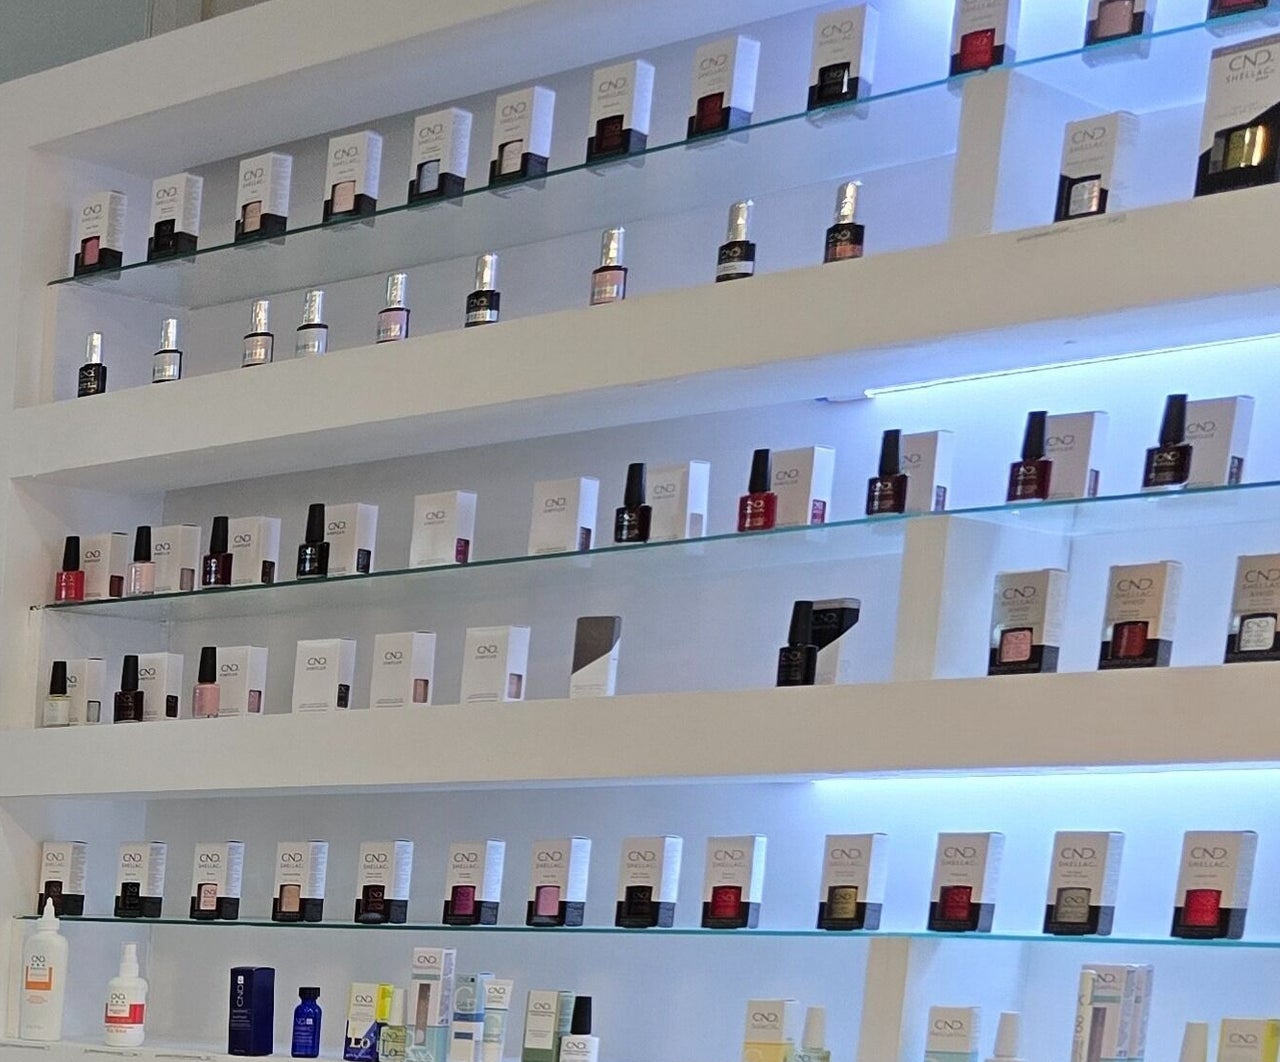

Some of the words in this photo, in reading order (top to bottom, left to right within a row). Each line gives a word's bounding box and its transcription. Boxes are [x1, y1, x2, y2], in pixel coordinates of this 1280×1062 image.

[1072, 127, 1106, 143] CND
[1117, 578, 1153, 593] CND
[1003, 586, 1036, 600] CND
[123, 853, 142, 862] CND
[199, 853, 220, 862] CND
[281, 853, 303, 862] CND
[364, 853, 388, 863] CND
[453, 852, 478, 863] CND
[537, 851, 562, 862] CND
[628, 851, 656, 862] CND
[714, 850, 745, 861] CND
[831, 848, 862, 860] CND
[944, 847, 976, 859] CND
[1061, 847, 1096, 859] CND
[1191, 847, 1227, 860] CND
[934, 1020, 963, 1030] CND
